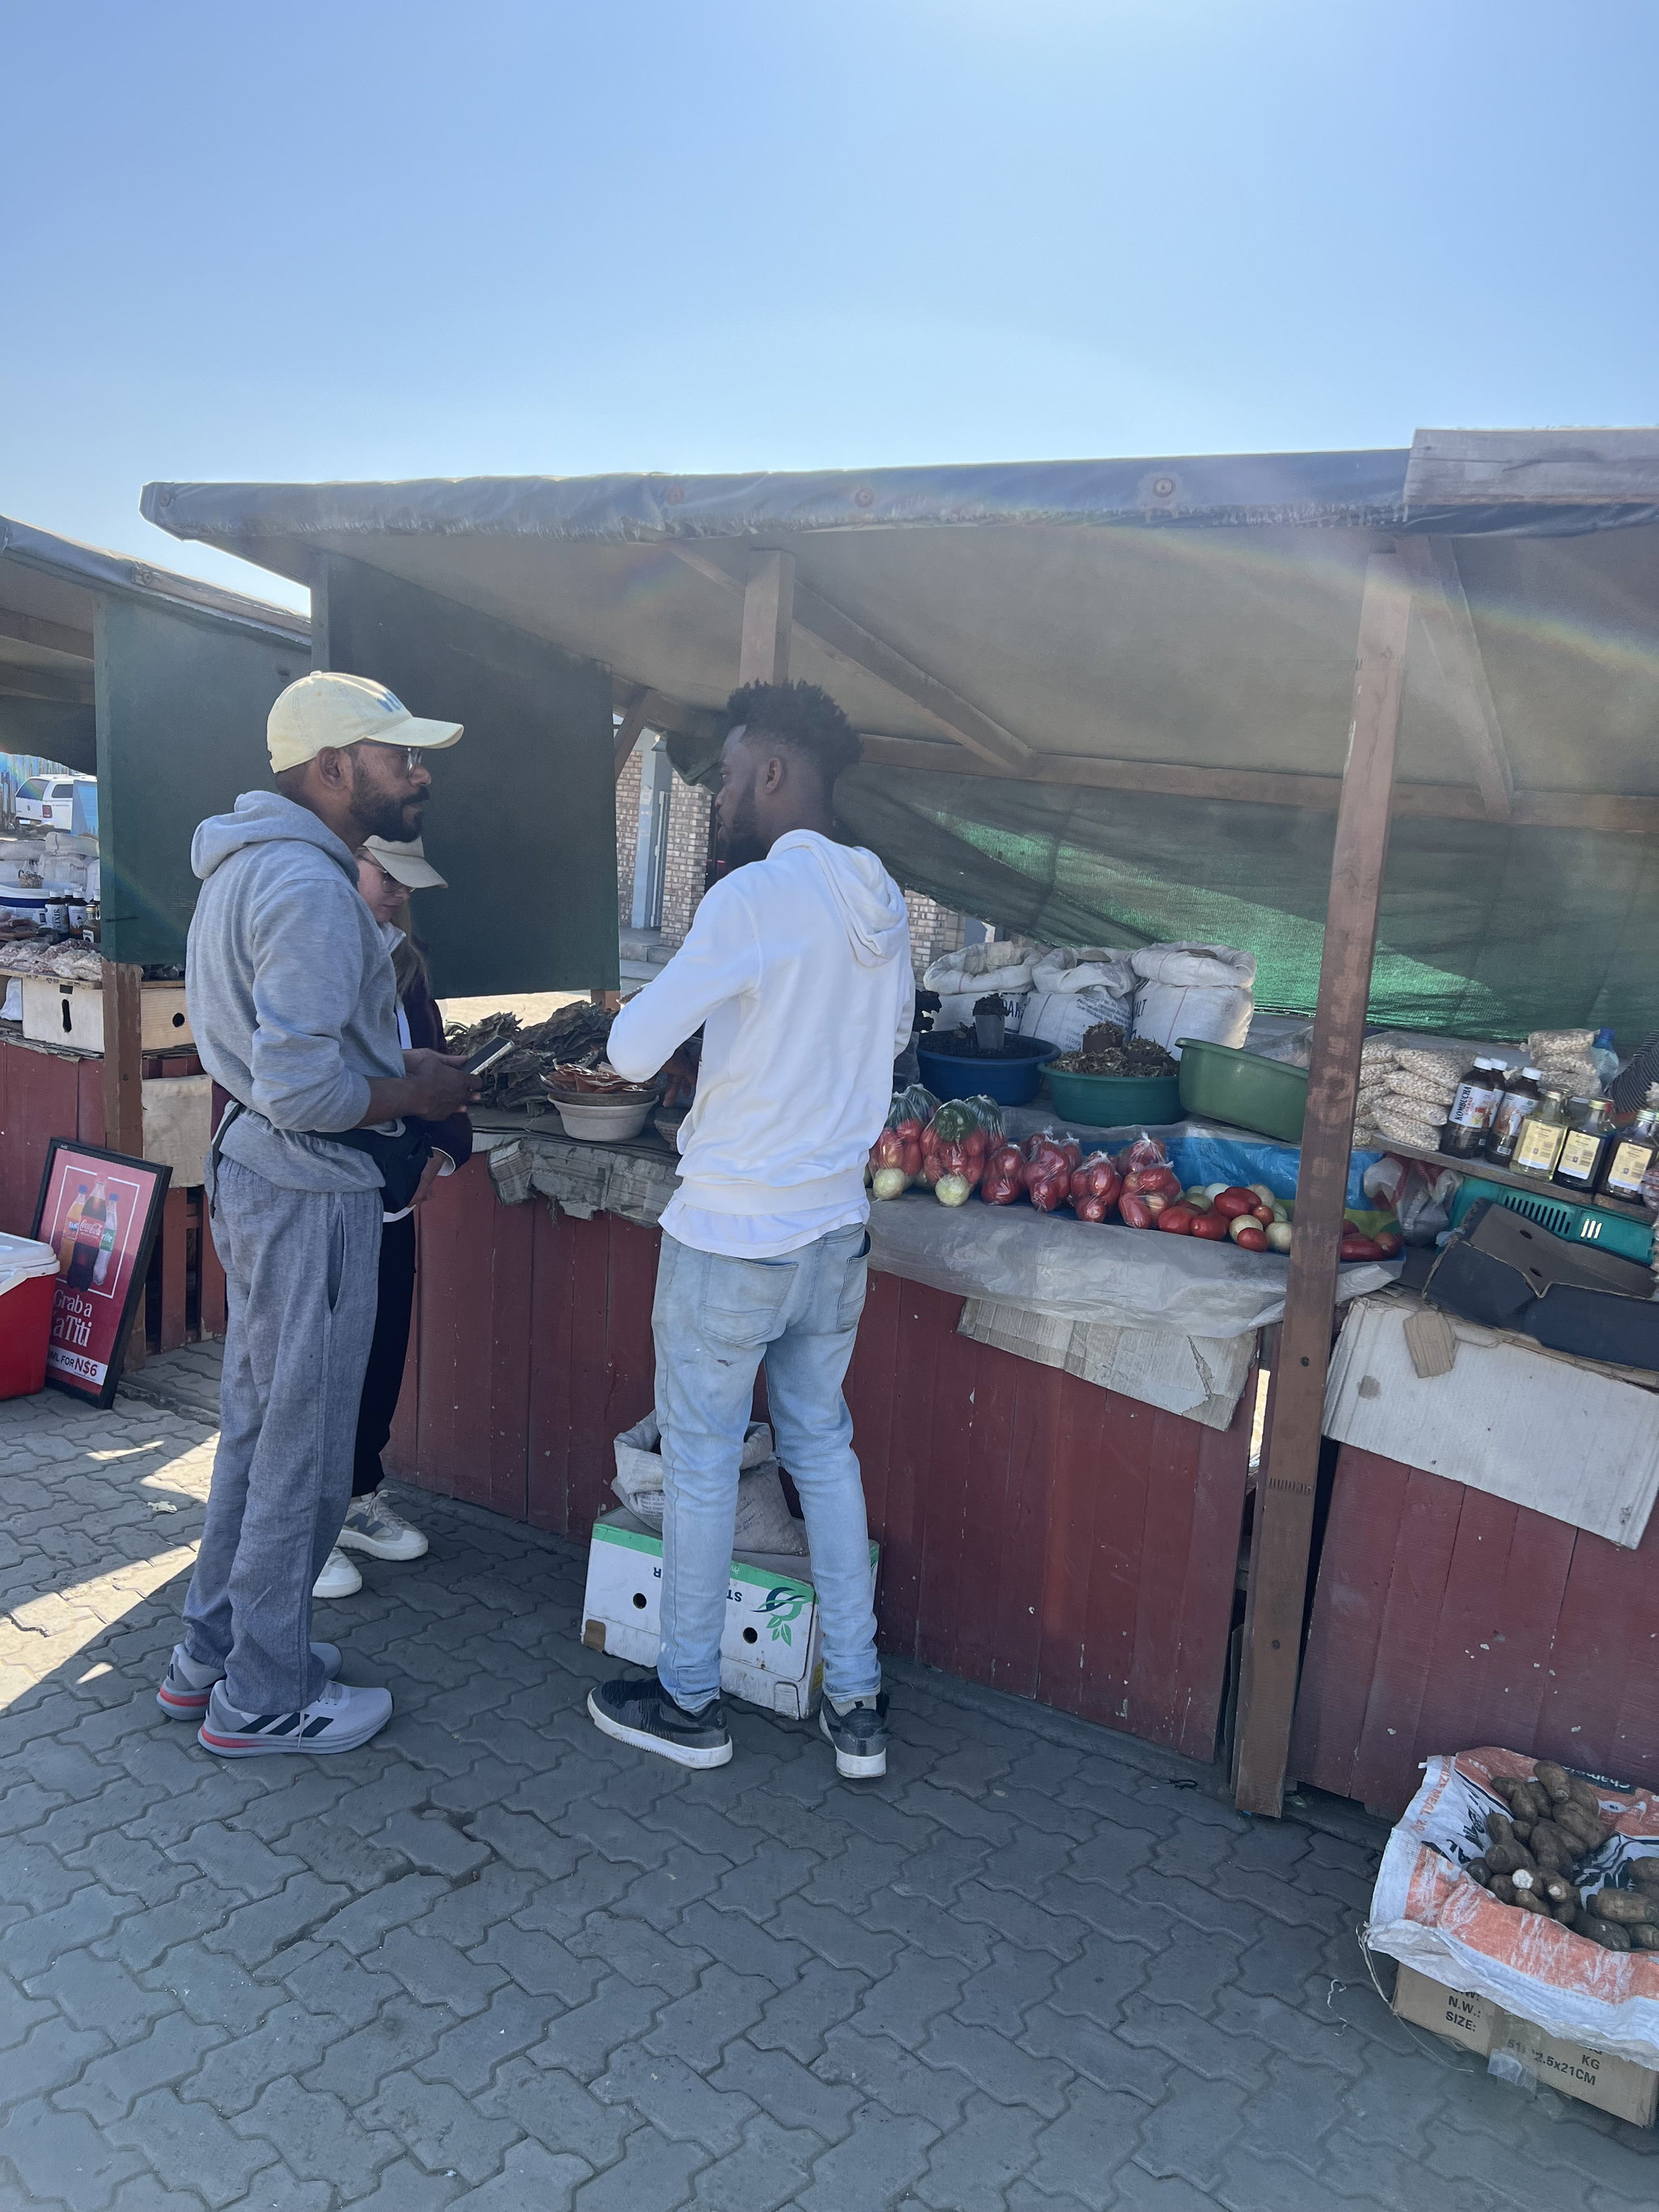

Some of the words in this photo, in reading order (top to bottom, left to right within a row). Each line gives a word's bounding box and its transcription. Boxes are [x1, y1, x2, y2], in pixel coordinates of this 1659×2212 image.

[1455, 1086, 1472, 1121] KOMBUCHA
[102, 1232, 113, 1243] rite
[53, 1289, 83, 1314] Grab
[83, 1302, 92, 1318] a
[53, 1315, 92, 1348] aTiti
[61, 1356, 75, 1368] FOR
[75, 1357, 98, 1377] N$6
[1448, 1995, 1481, 2018] N.W.:
[1445, 2011, 1476, 2032] SIZE:
[1582, 2054, 1601, 2070] KG
